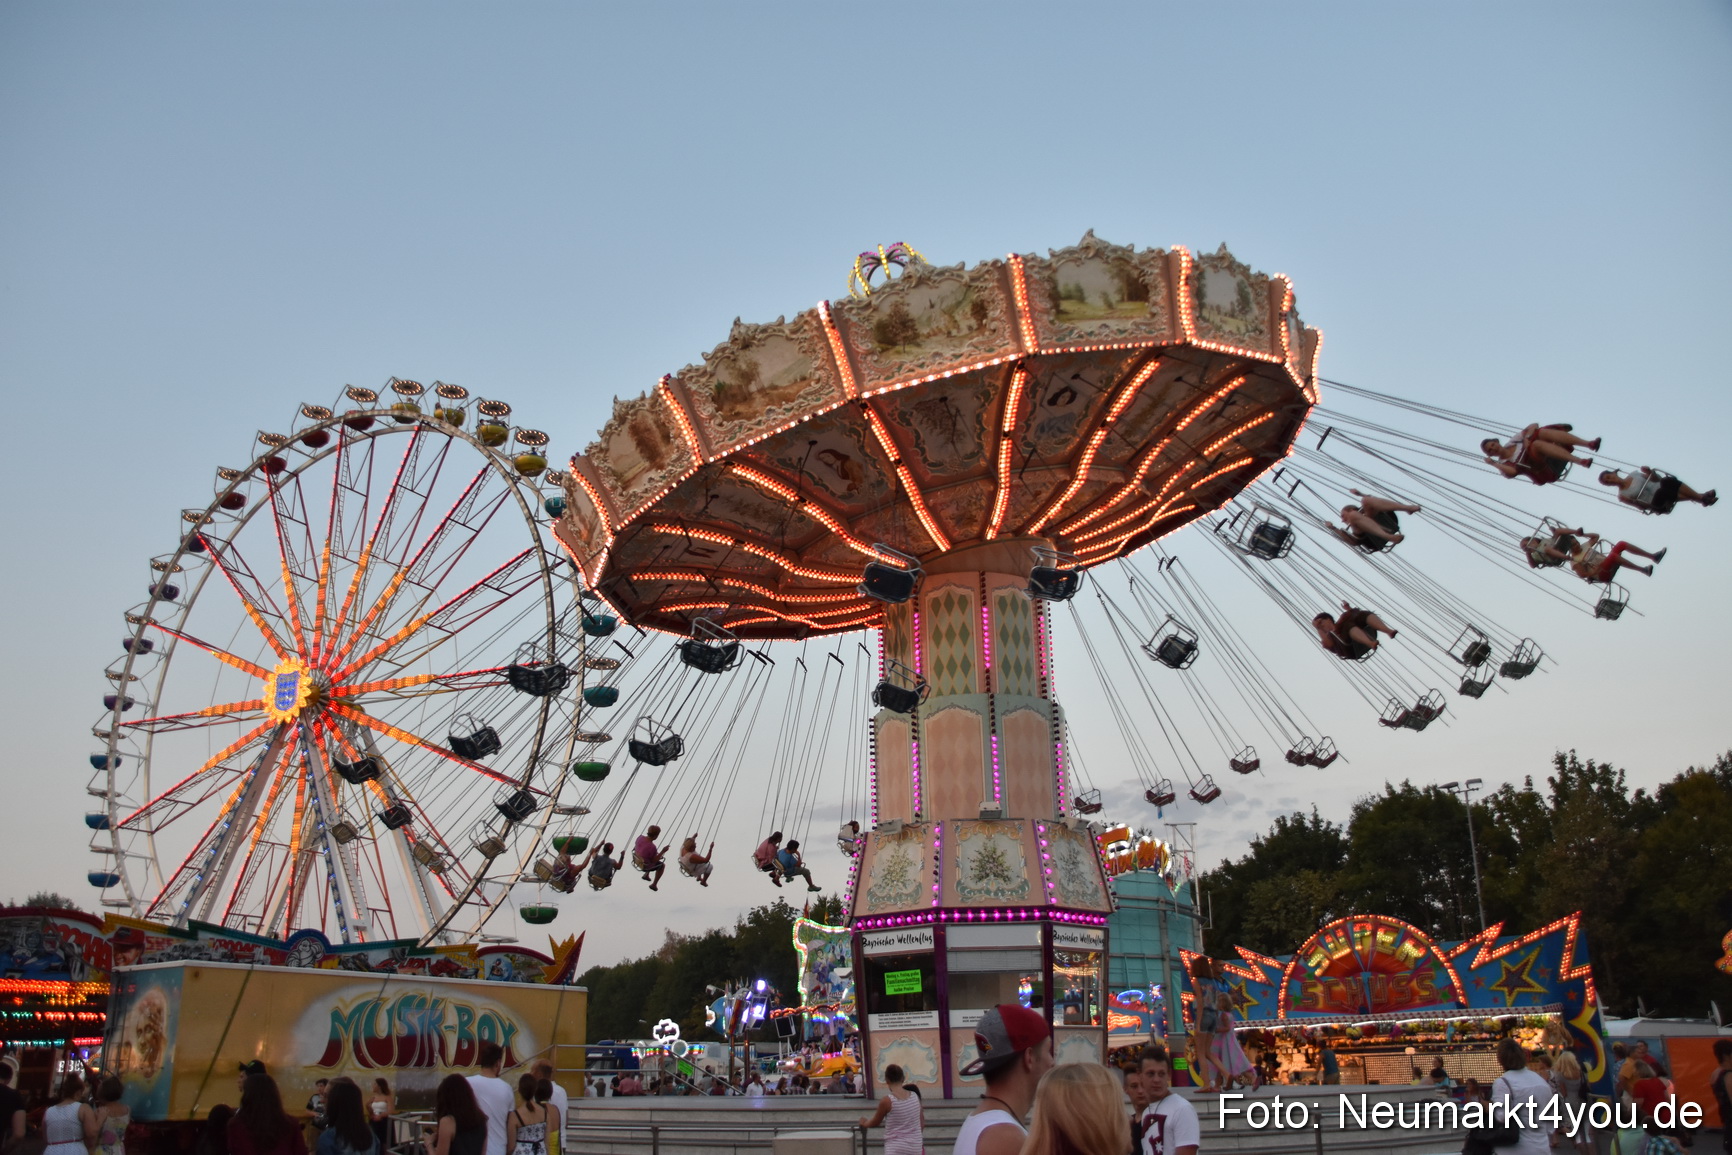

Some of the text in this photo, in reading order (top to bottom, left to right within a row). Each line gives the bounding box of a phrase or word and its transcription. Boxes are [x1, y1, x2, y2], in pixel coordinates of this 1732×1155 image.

[897, 932, 932, 945] Wellenflug
[1302, 921, 1427, 977] SUPER
[1301, 972, 1436, 1008] SCHUSS
